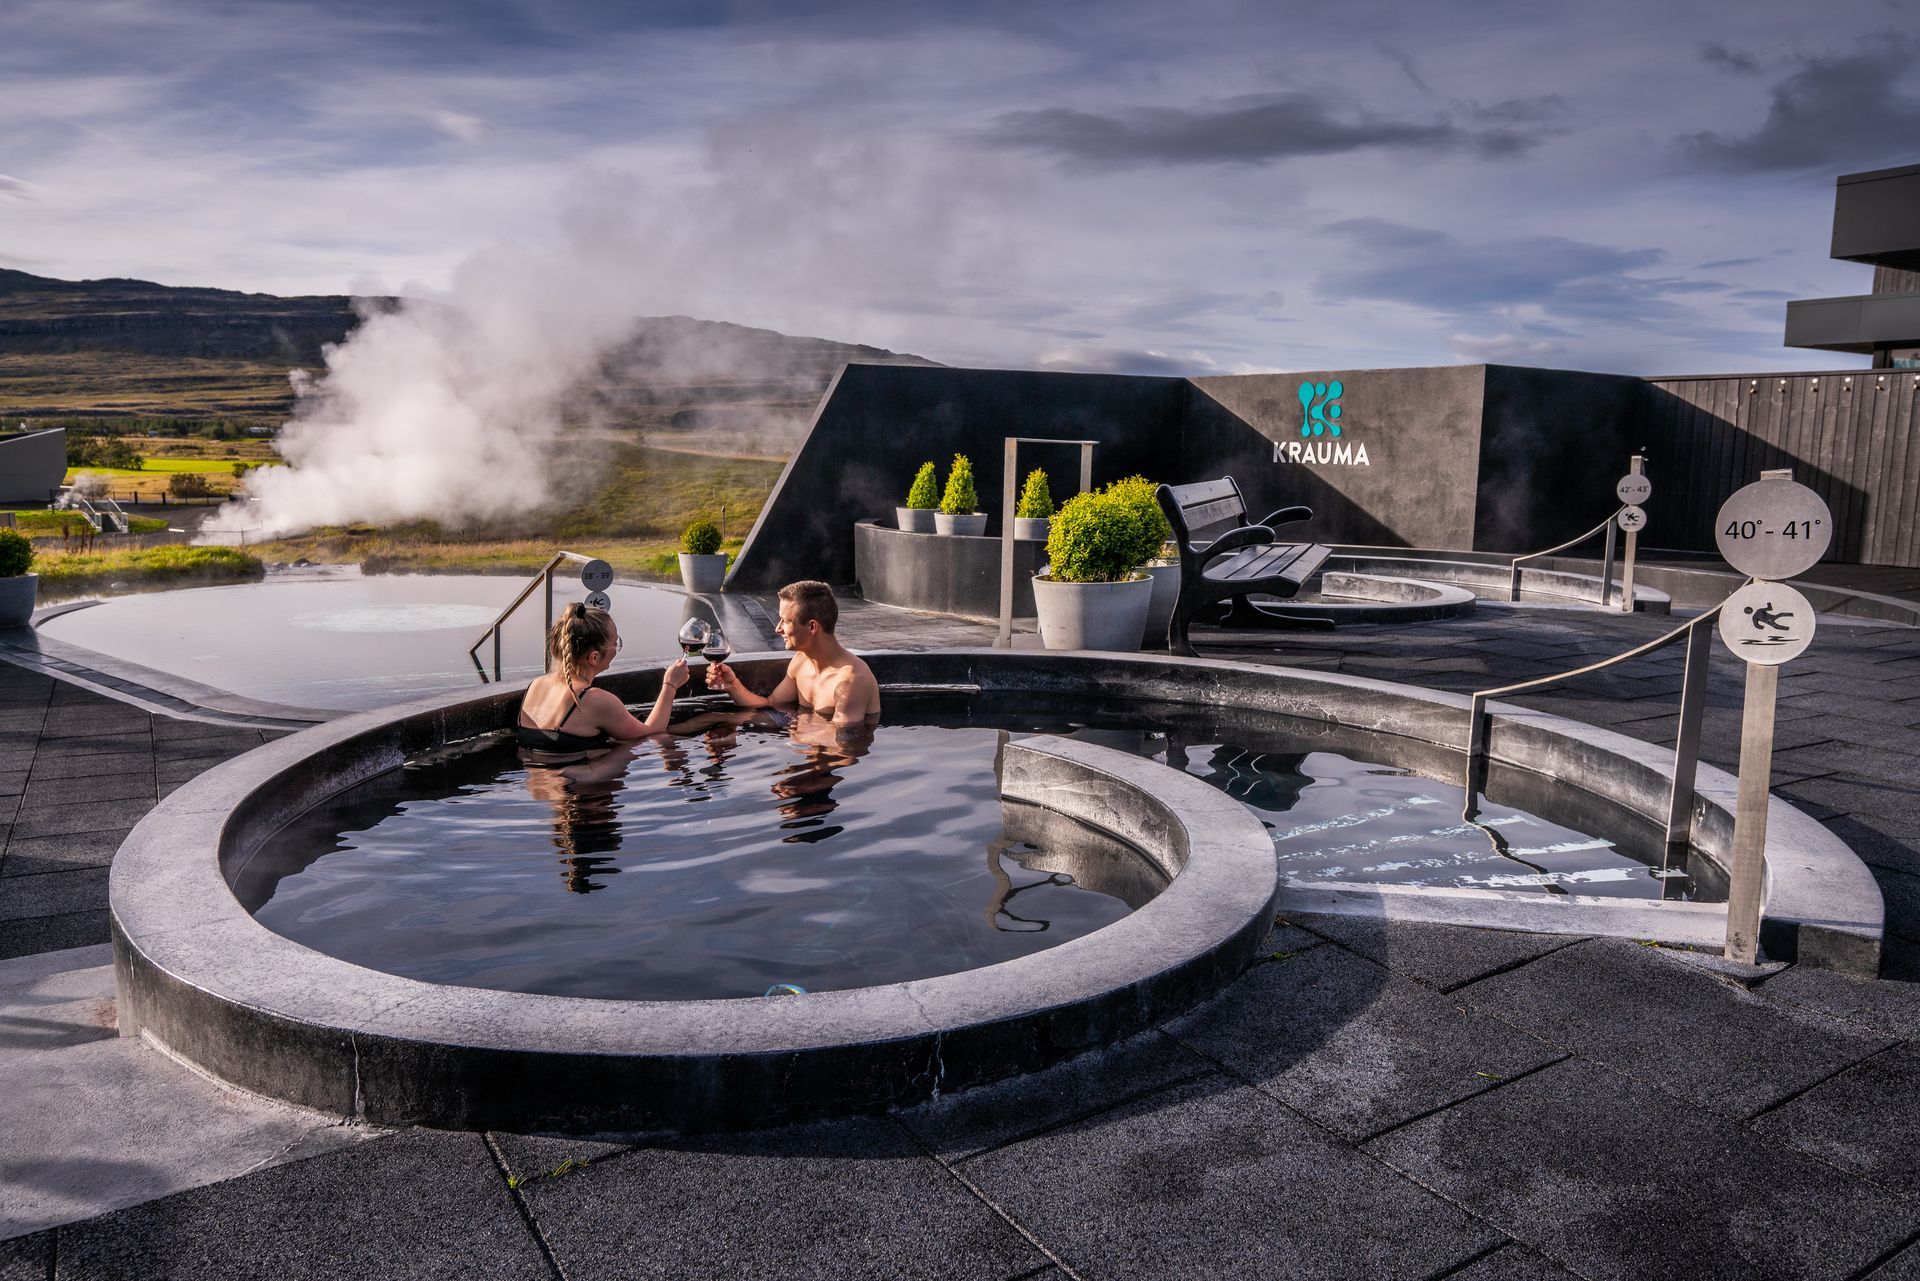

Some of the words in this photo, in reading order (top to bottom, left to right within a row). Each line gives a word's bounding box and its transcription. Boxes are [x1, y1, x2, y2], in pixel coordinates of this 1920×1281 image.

[1273, 441, 1370, 466] KRAUMA
[1725, 520, 1762, 539] 40°
[1783, 520, 1821, 539] 41°
